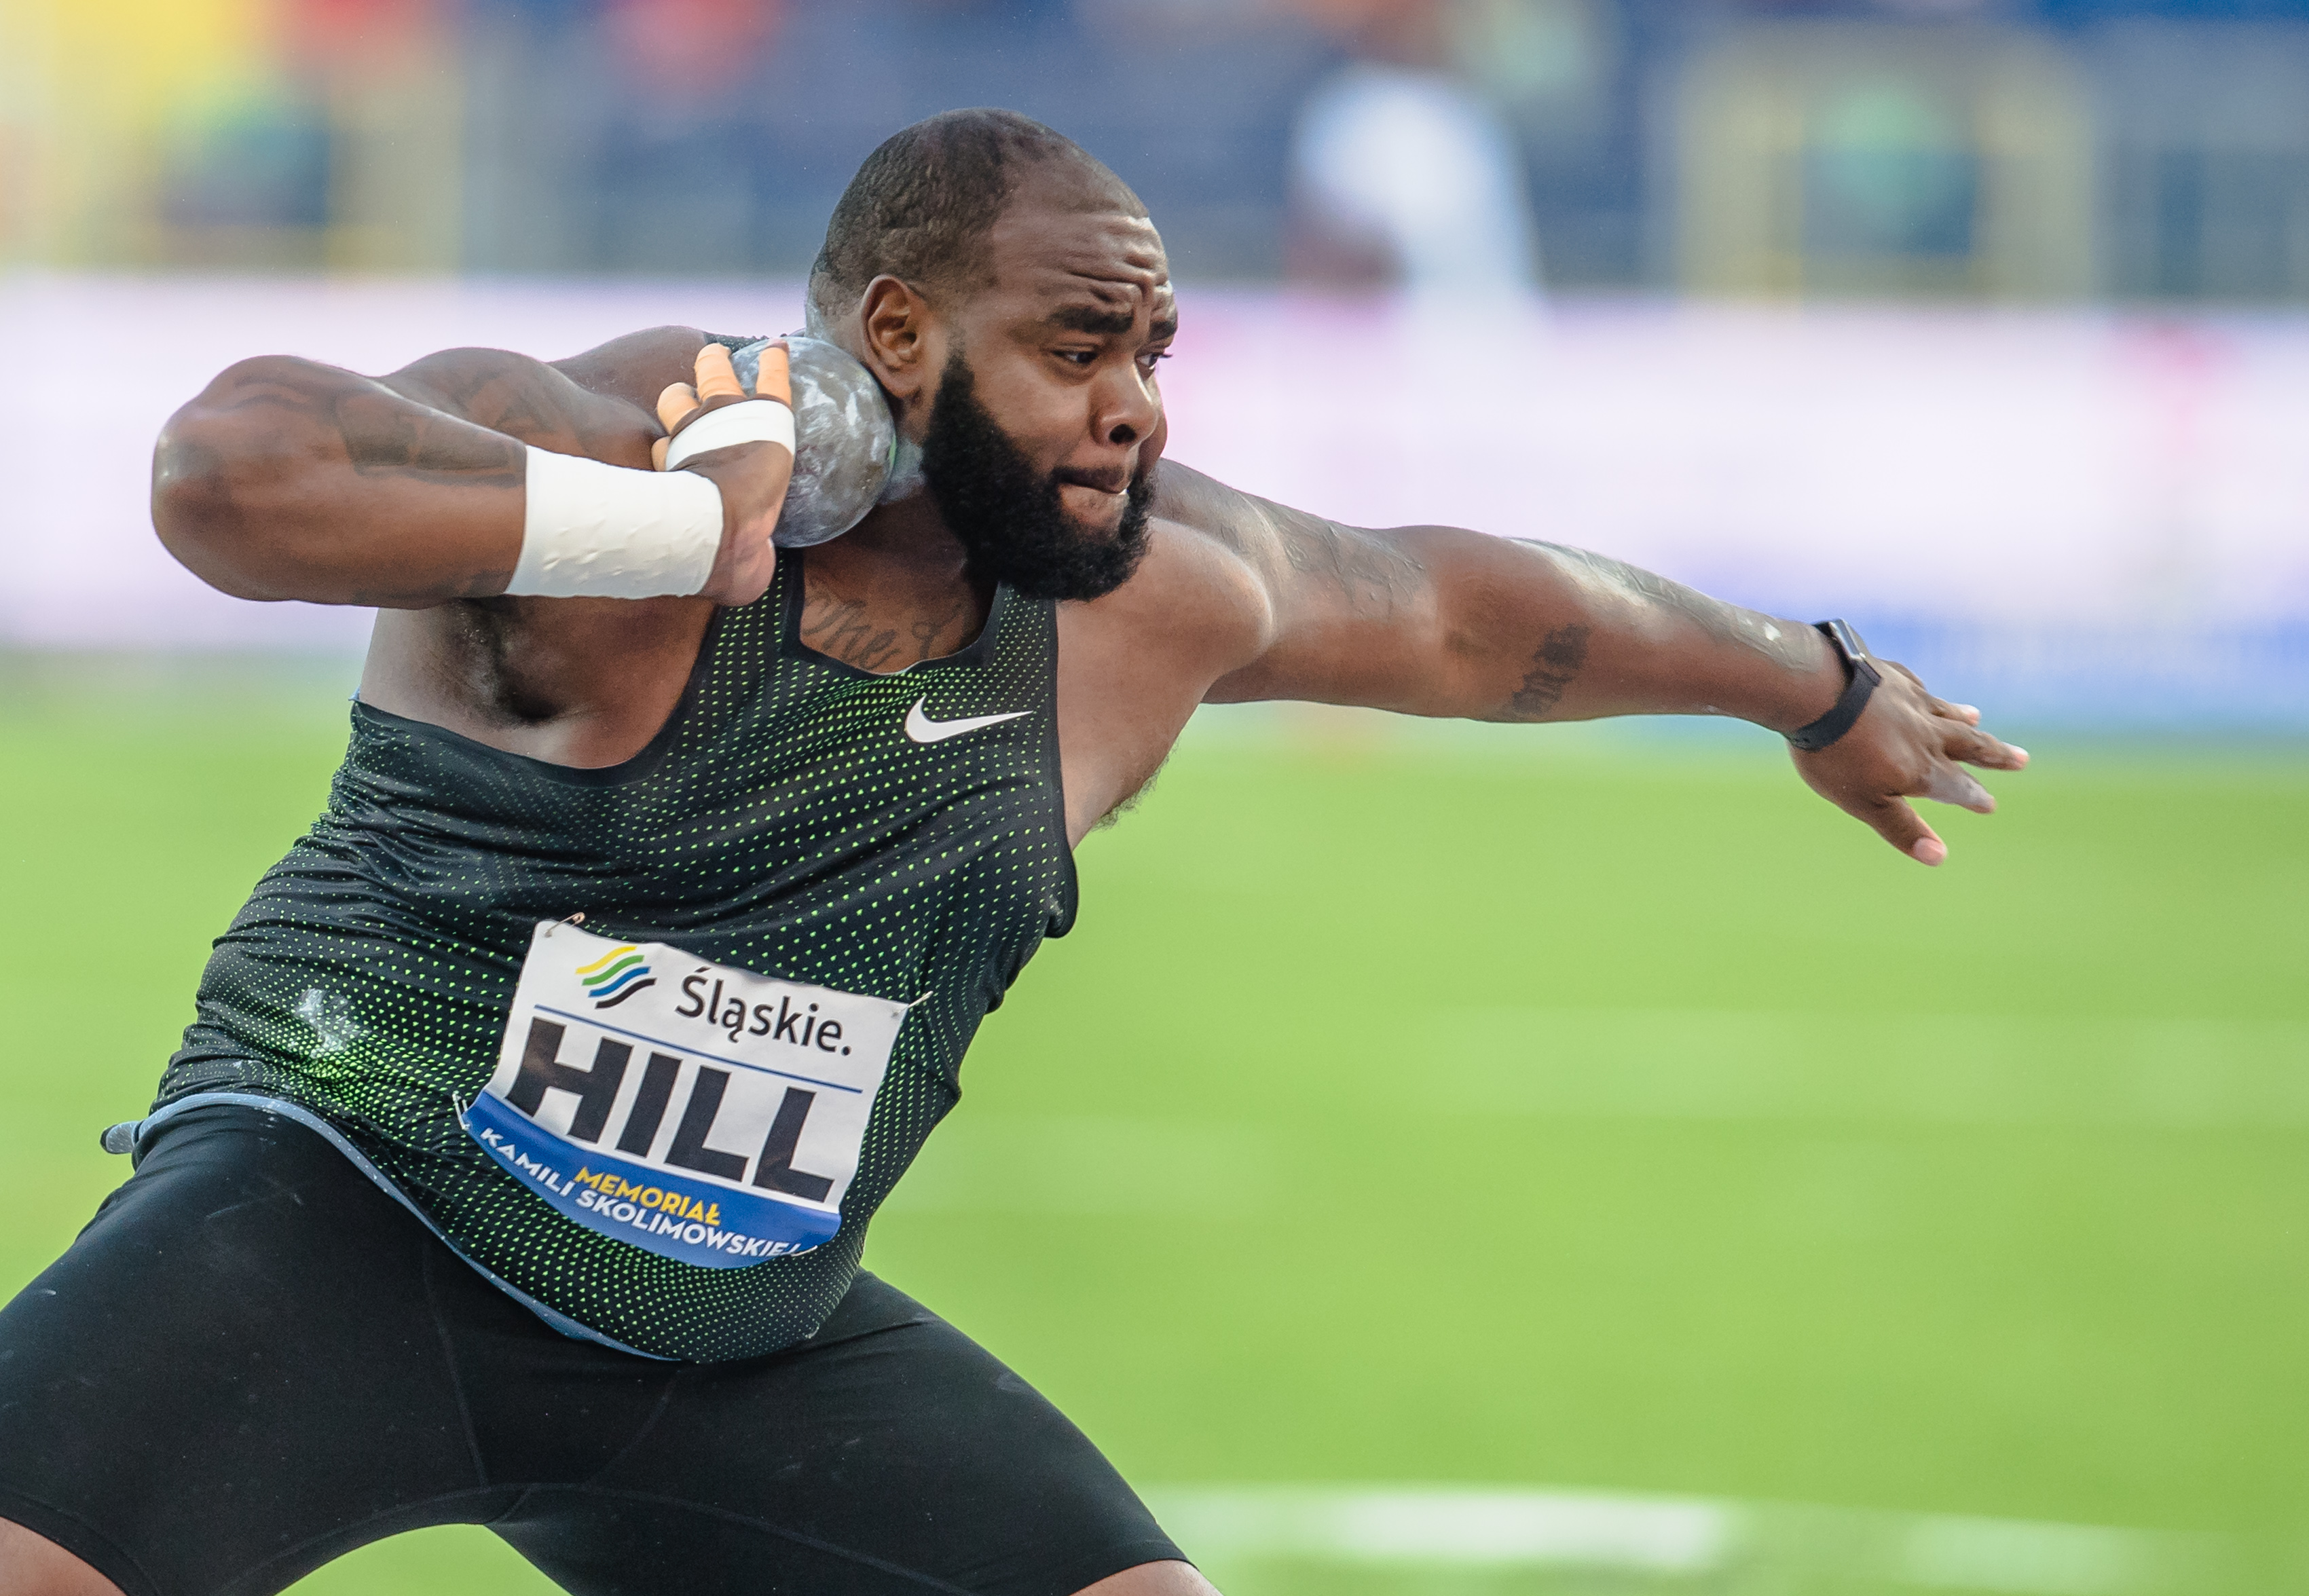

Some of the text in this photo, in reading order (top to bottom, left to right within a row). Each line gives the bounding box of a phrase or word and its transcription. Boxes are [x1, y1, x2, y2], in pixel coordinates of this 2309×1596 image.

[675, 965, 851, 1056] Śląskie.
[504, 1016, 834, 1203] HILL
[479, 1127, 801, 1257] KAMILI SKOLIMOWSKIEJ
[573, 1166, 722, 1227] MEMORIAŁ
